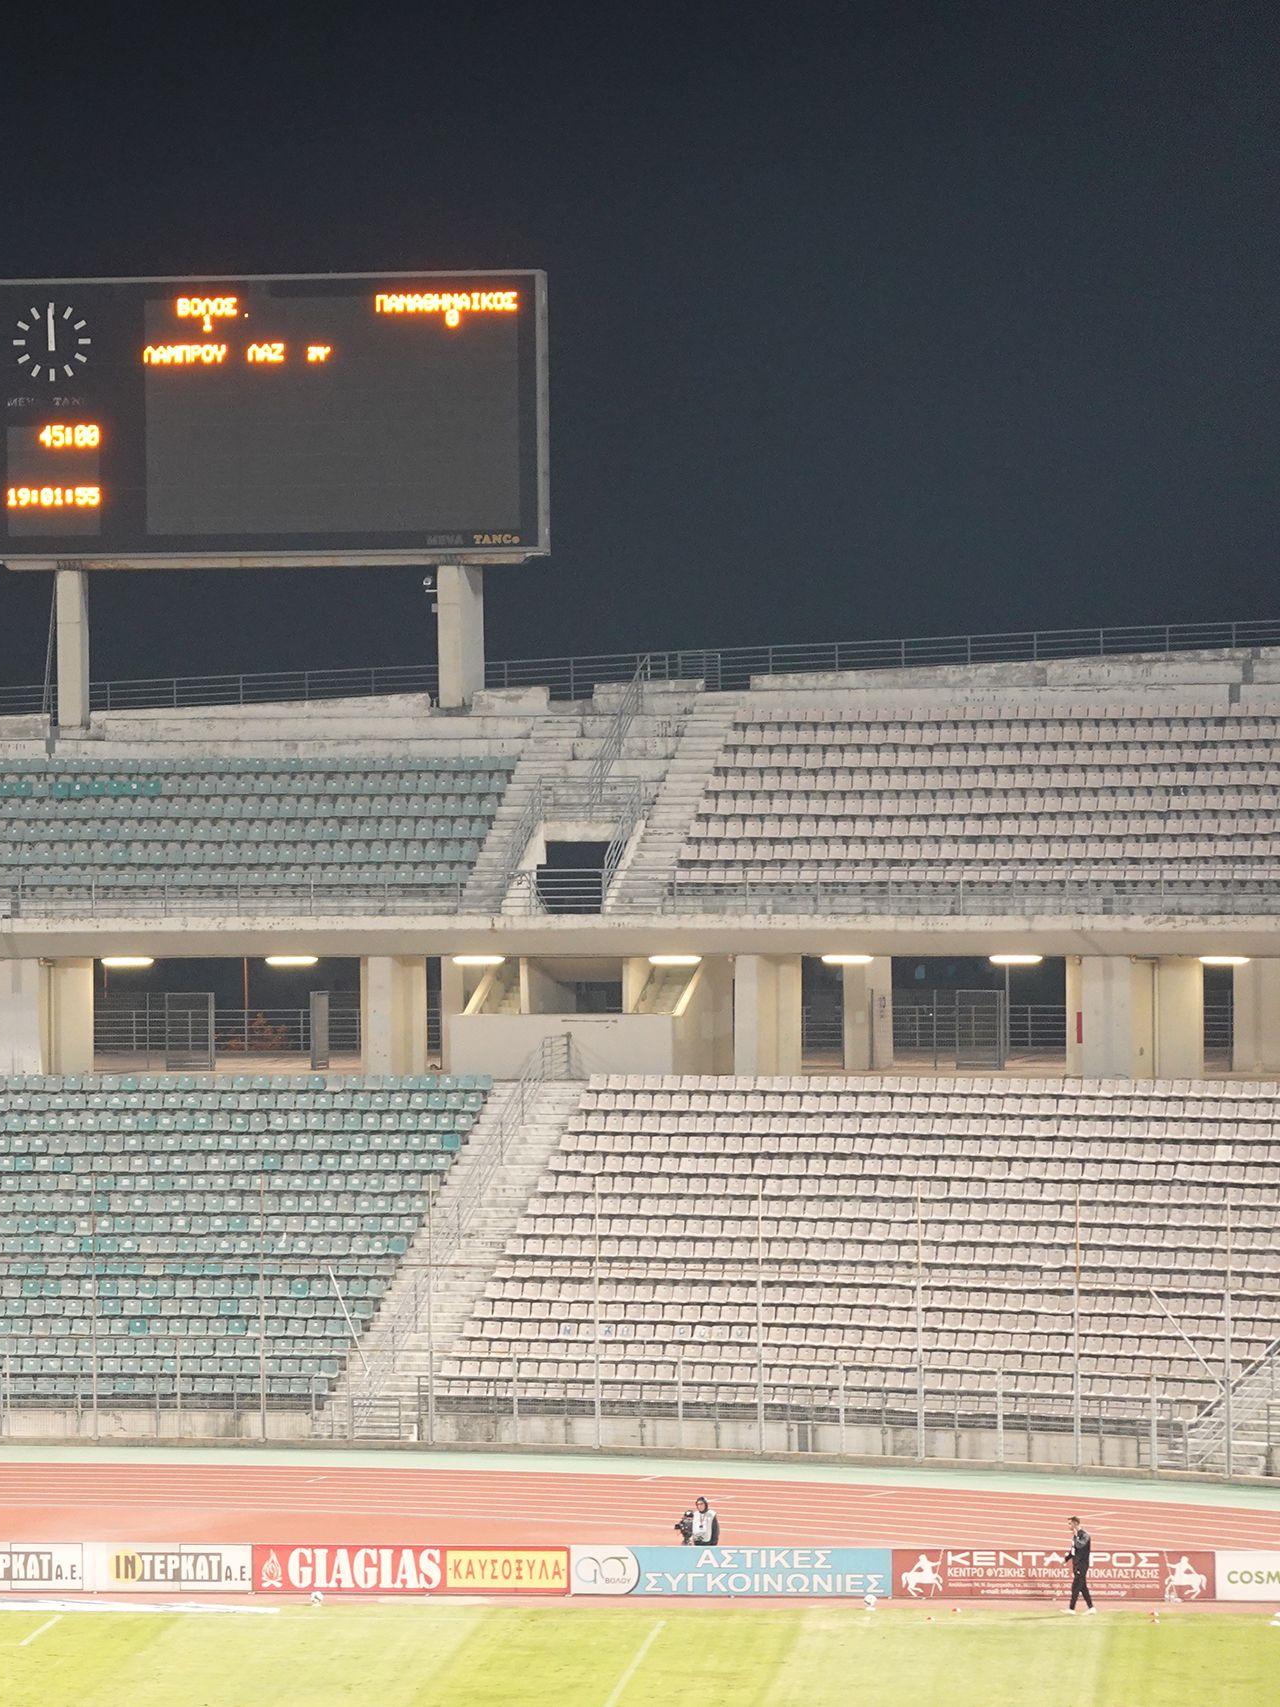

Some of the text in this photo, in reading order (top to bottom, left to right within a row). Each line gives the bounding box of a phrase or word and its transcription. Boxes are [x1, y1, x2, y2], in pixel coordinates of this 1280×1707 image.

[176, 297, 238, 317] ΒΟΛΟΣ
[203, 313, 213, 332] 1
[143, 344, 227, 364] ΛΑΜΠΡΟΥ
[247, 343, 285, 363] ΛΑΖ
[39, 424, 100, 447] 45:00
[7, 486, 100, 507] 19:01:55
[288, 1547, 442, 1588] GIAGIAS
[696, 1549, 832, 1569] ΑΣΤΙΚΕΣ
[946, 1551, 1160, 1568] ΚΕΝΤΑΡΟΣ
[947, 1567, 1160, 1579] ΚΕΝΤΡΟ ΦΥΣΙΚΗΣ ΙΑΤΡΙΚΗΣ ΠΟΚΑΤΑΣΤΑΣΗΣ
[644, 1573, 885, 1594] ΣΥΓΚΟΙΝΩΝΙΕΣ
